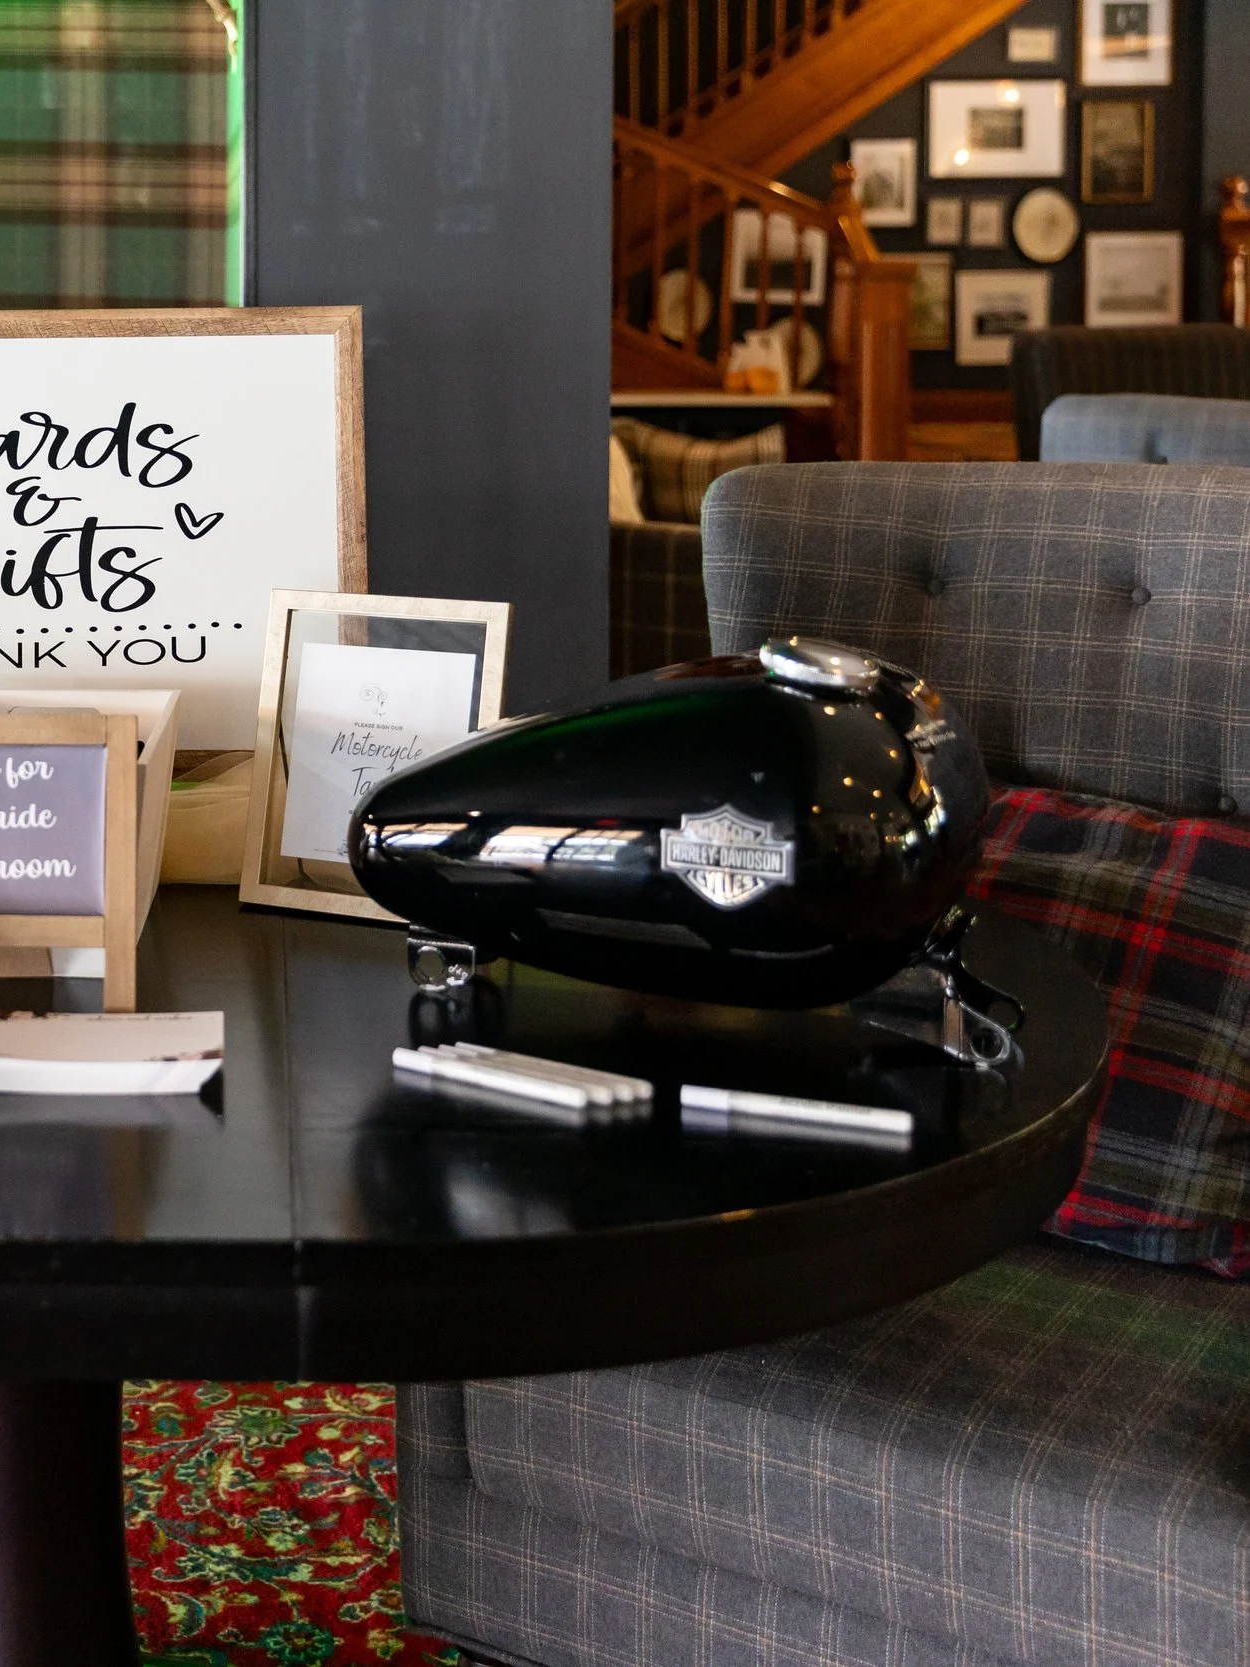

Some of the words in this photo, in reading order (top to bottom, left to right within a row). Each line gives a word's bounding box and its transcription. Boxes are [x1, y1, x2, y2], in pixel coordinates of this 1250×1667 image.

[5, 476, 82, 527] &
[86, 635, 208, 667] YOU
[331, 731, 423, 770] Motorcycle
[5, 755, 54, 789] for
[672, 843, 781, 872] HARLEY-DAVIDSON
